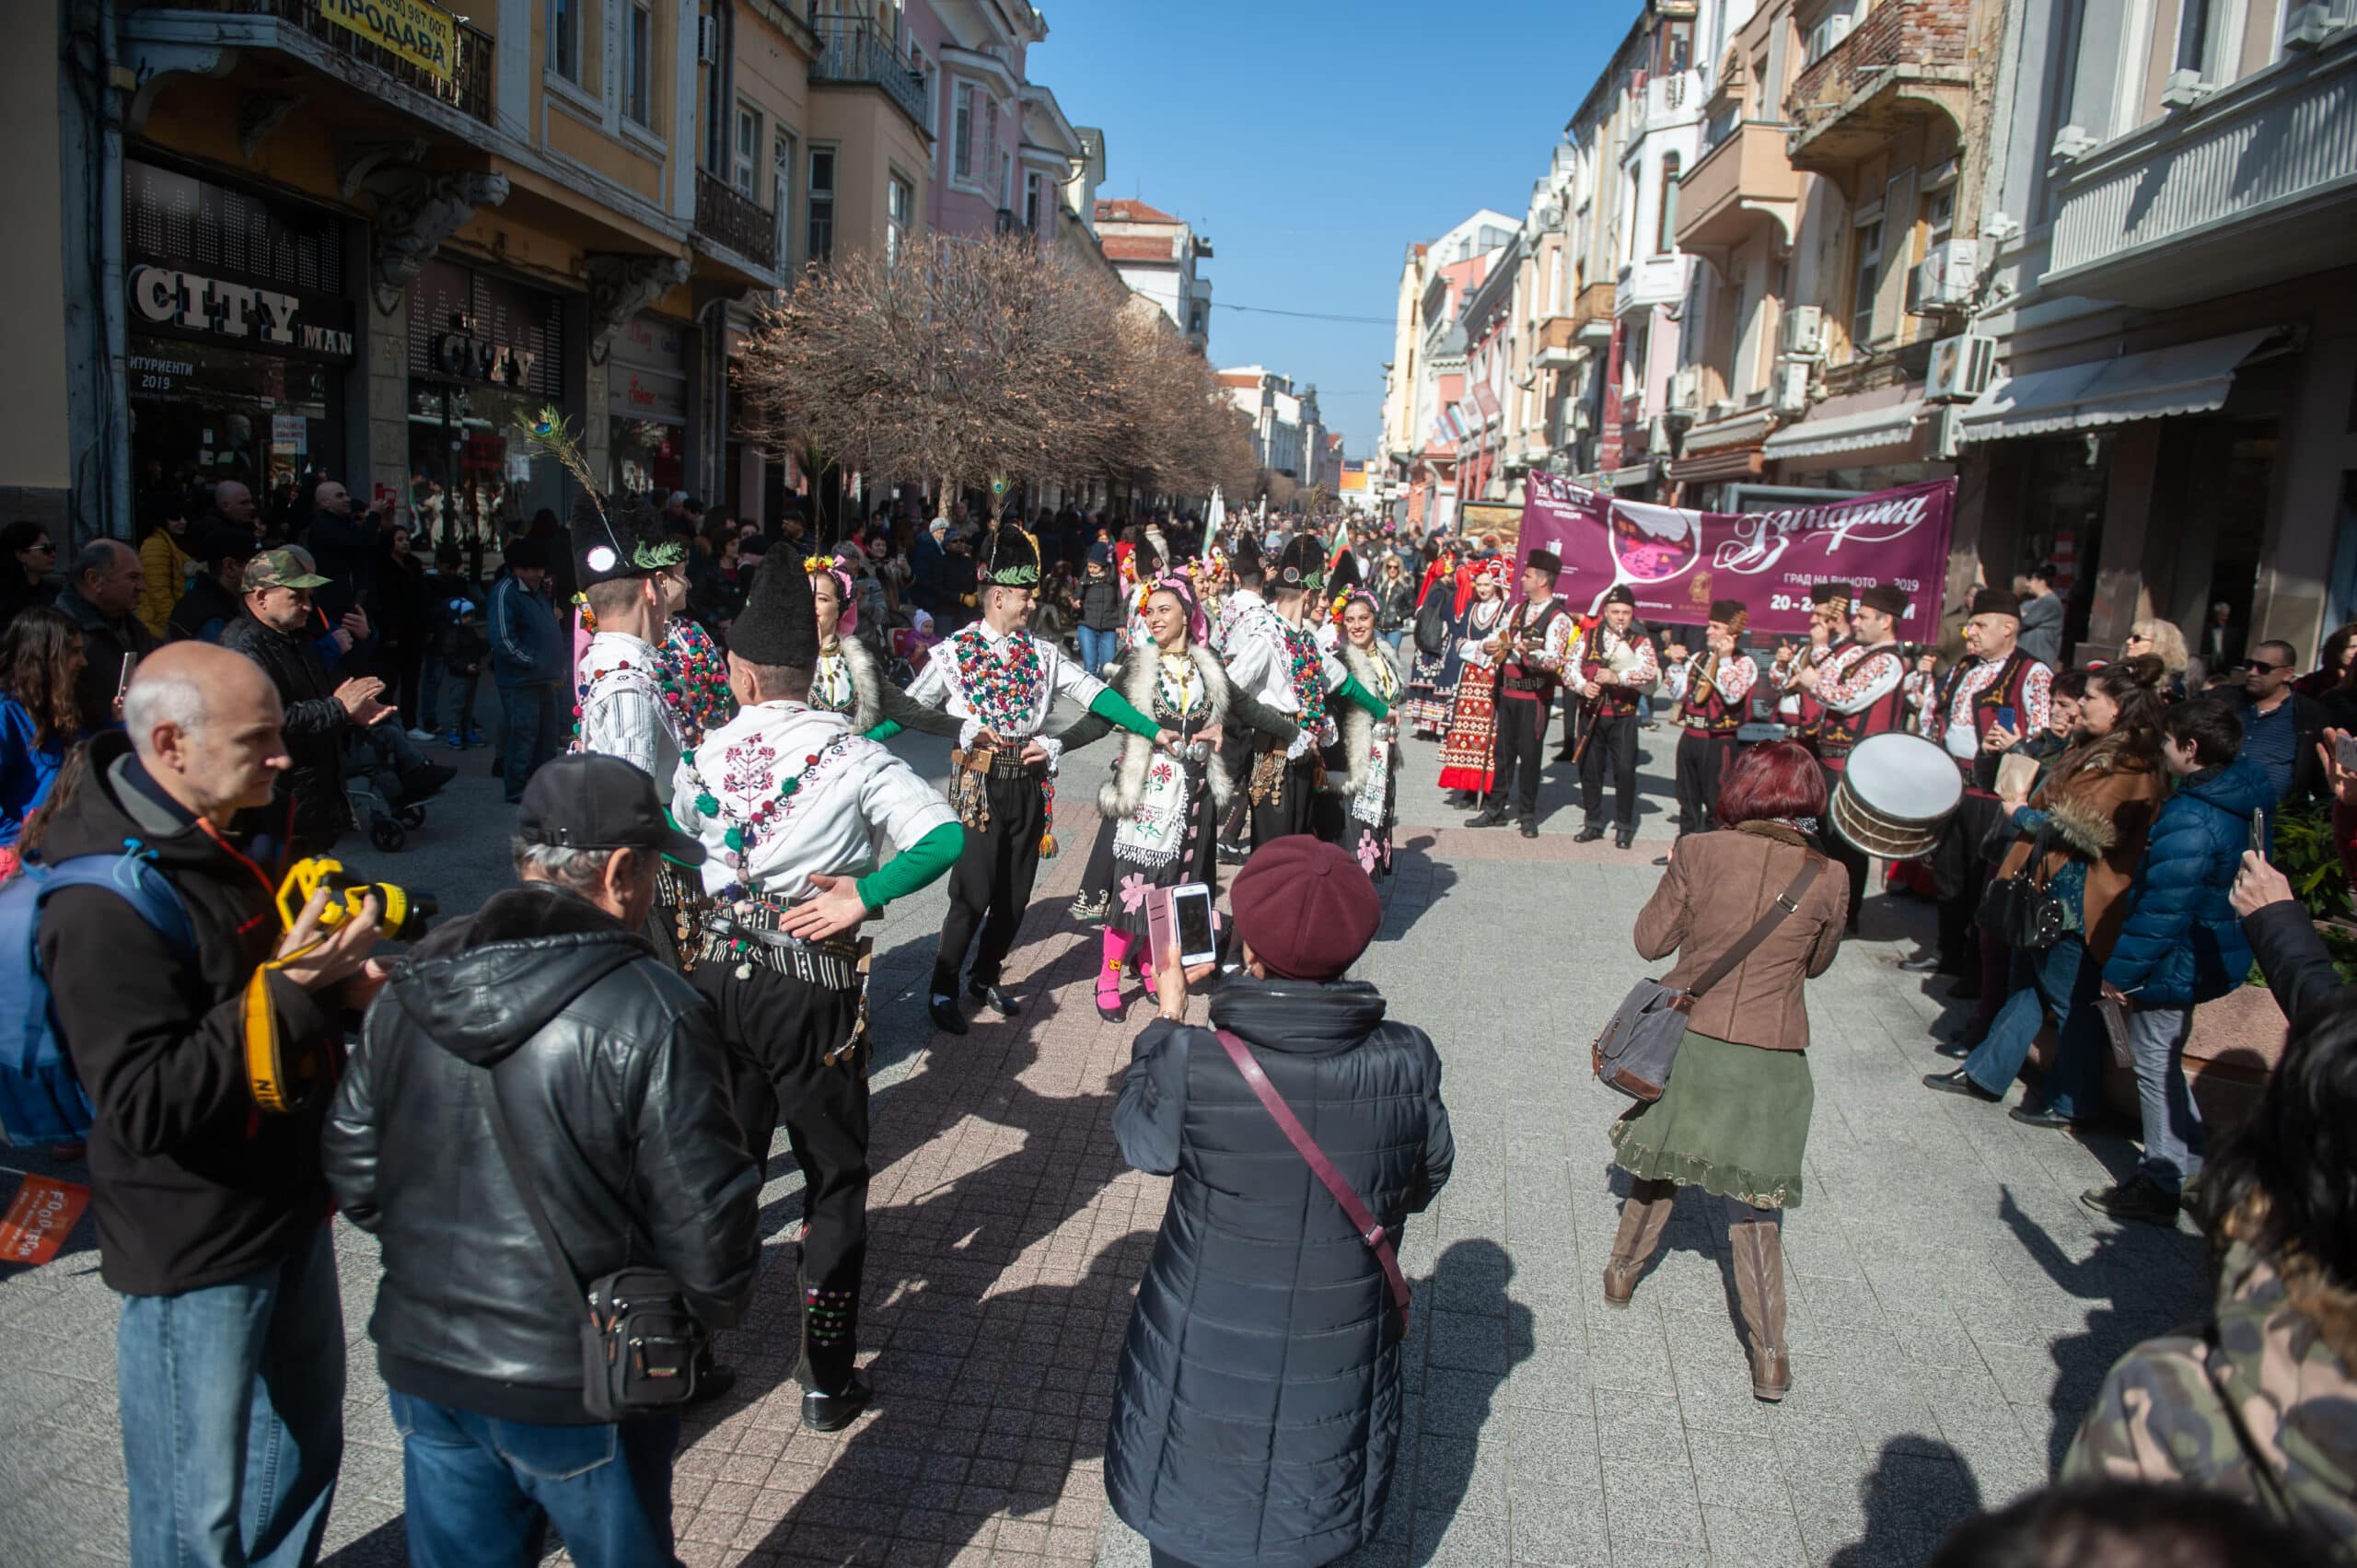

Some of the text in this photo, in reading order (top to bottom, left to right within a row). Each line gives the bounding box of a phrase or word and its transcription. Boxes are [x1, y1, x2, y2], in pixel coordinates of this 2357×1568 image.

[129, 265, 354, 354] CITY MAN
[142, 375, 170, 389] 2019
[1713, 494, 1930, 575] Винария
[1783, 573, 1812, 586] ГРАД
[1813, 575, 1829, 585] НА
[1770, 594, 1790, 610] 20
